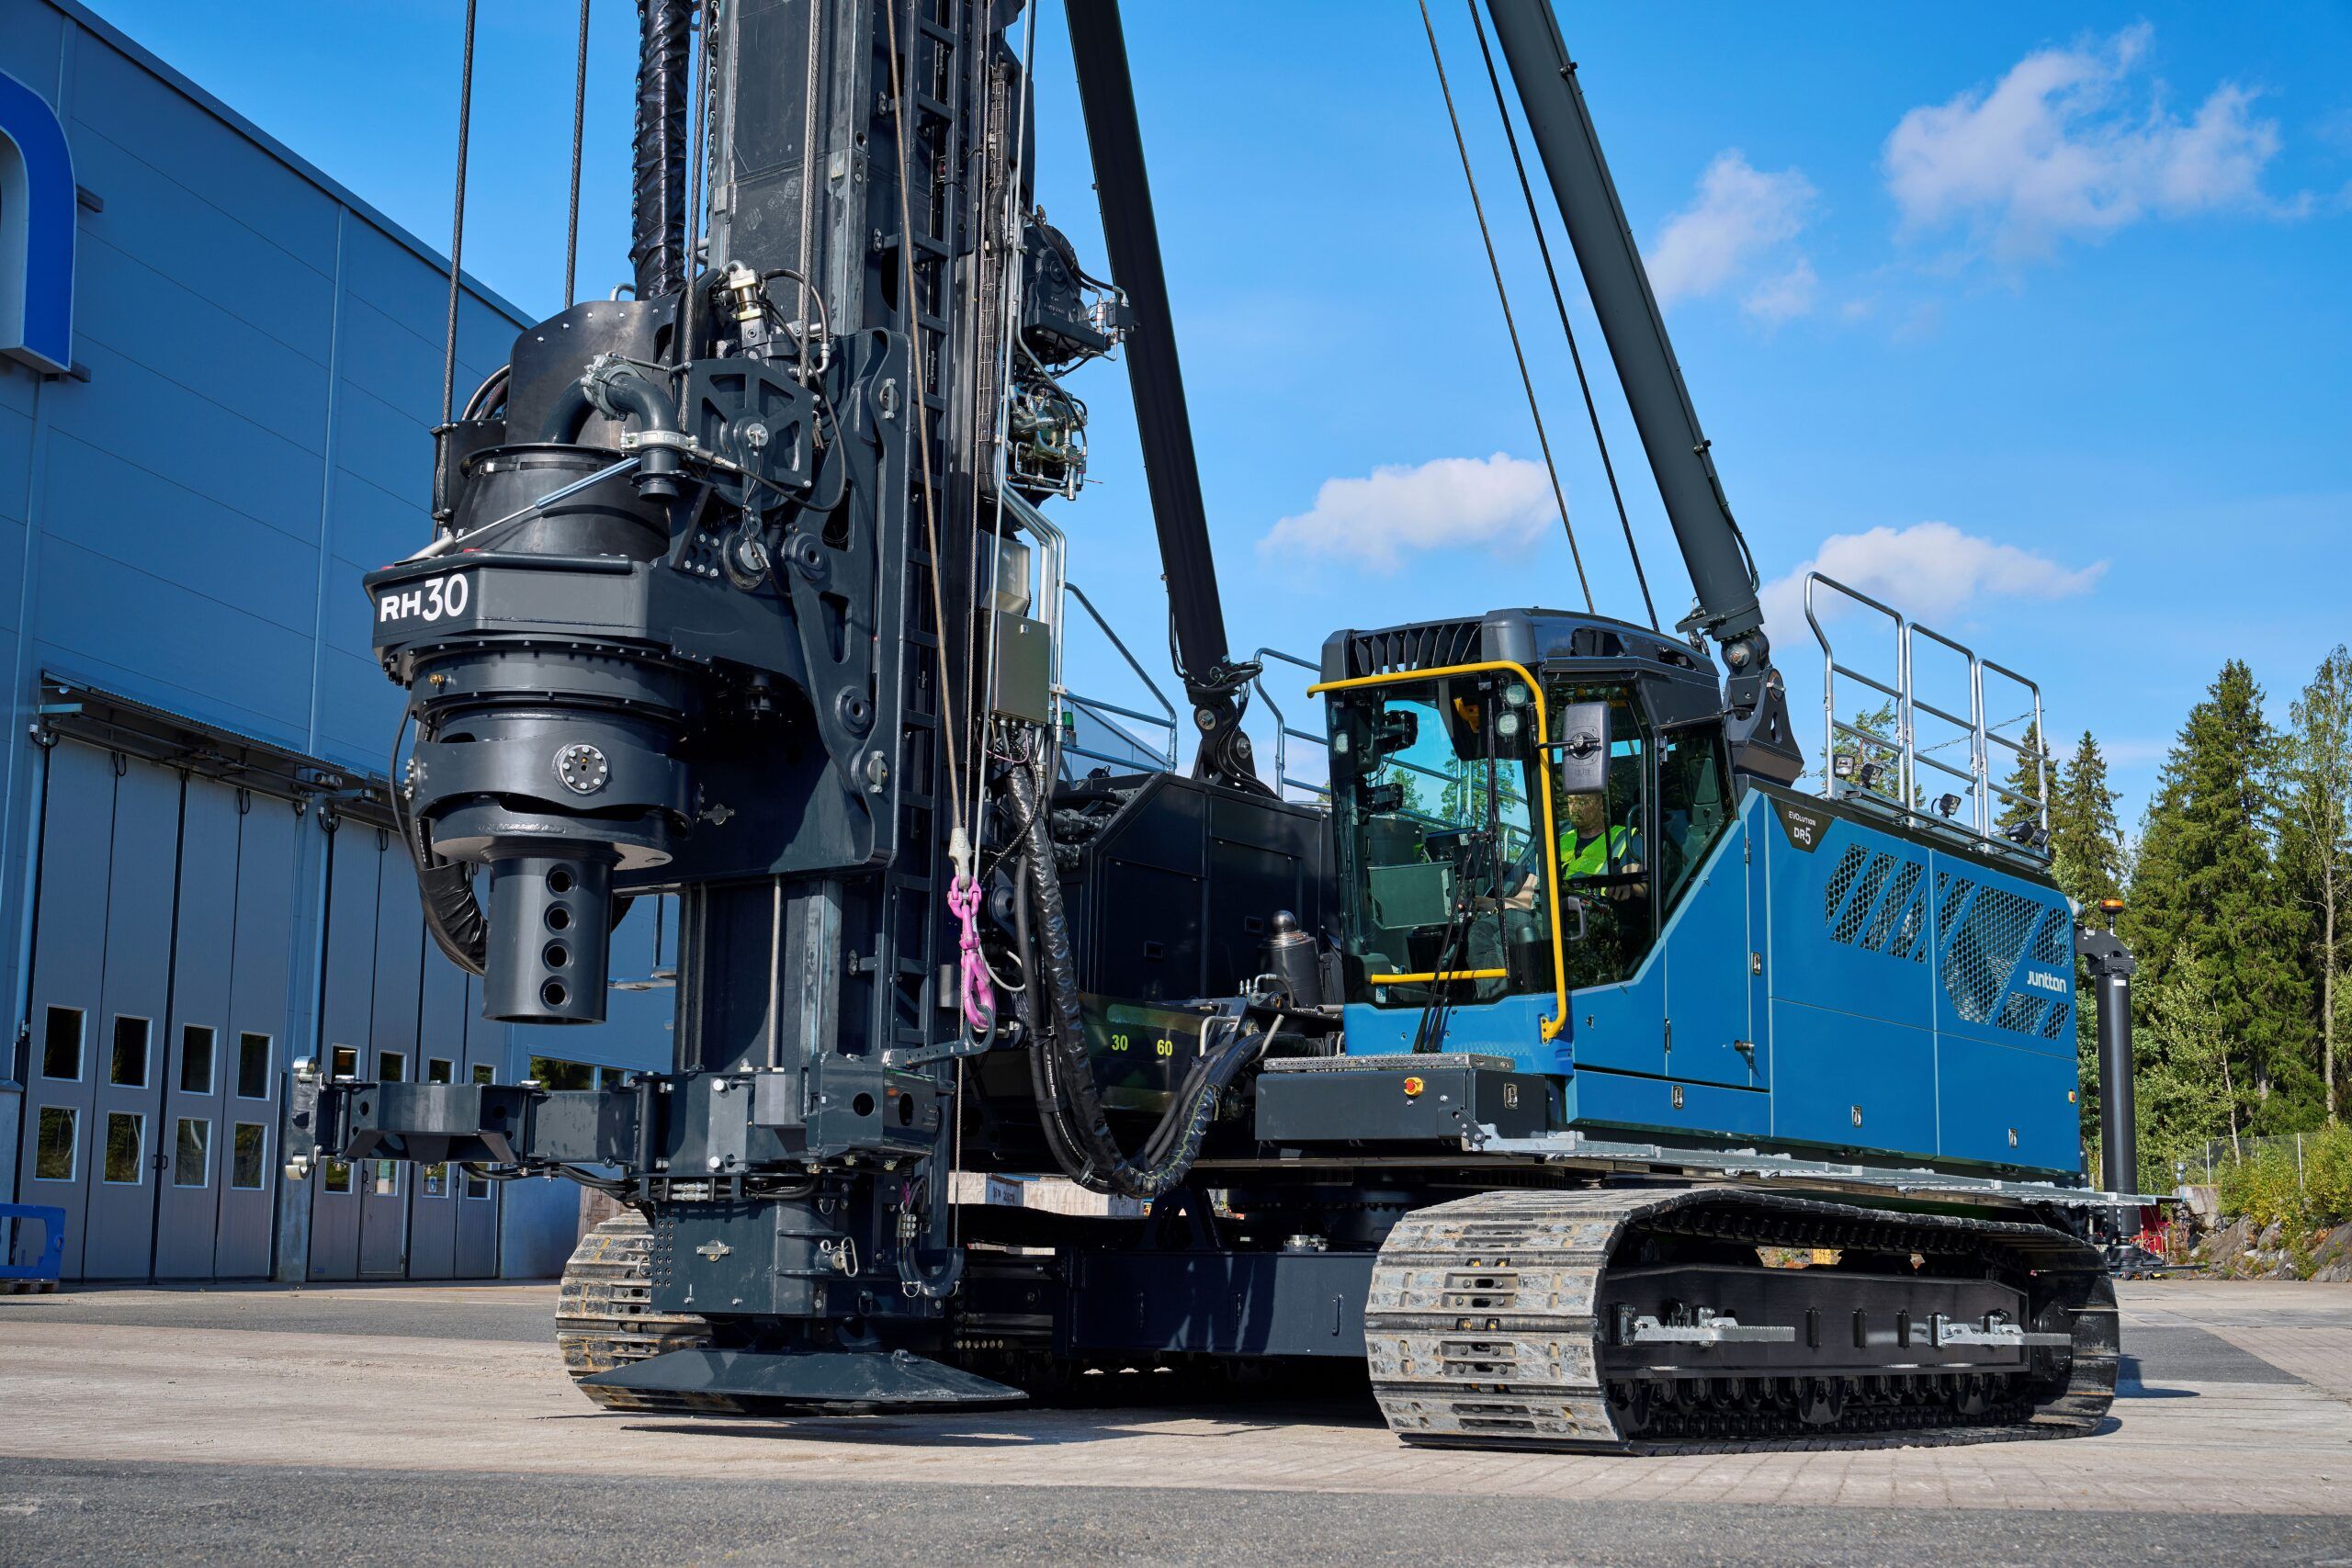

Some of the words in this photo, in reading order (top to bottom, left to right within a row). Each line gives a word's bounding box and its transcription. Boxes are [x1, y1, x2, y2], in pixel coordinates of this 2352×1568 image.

[379, 573, 469, 622] RH30
[1793, 827, 1812, 845] DR5
[2027, 970, 2067, 994] Junttan
[1111, 1034, 1128, 1052] 30
[1157, 1039, 1173, 1056] 60
